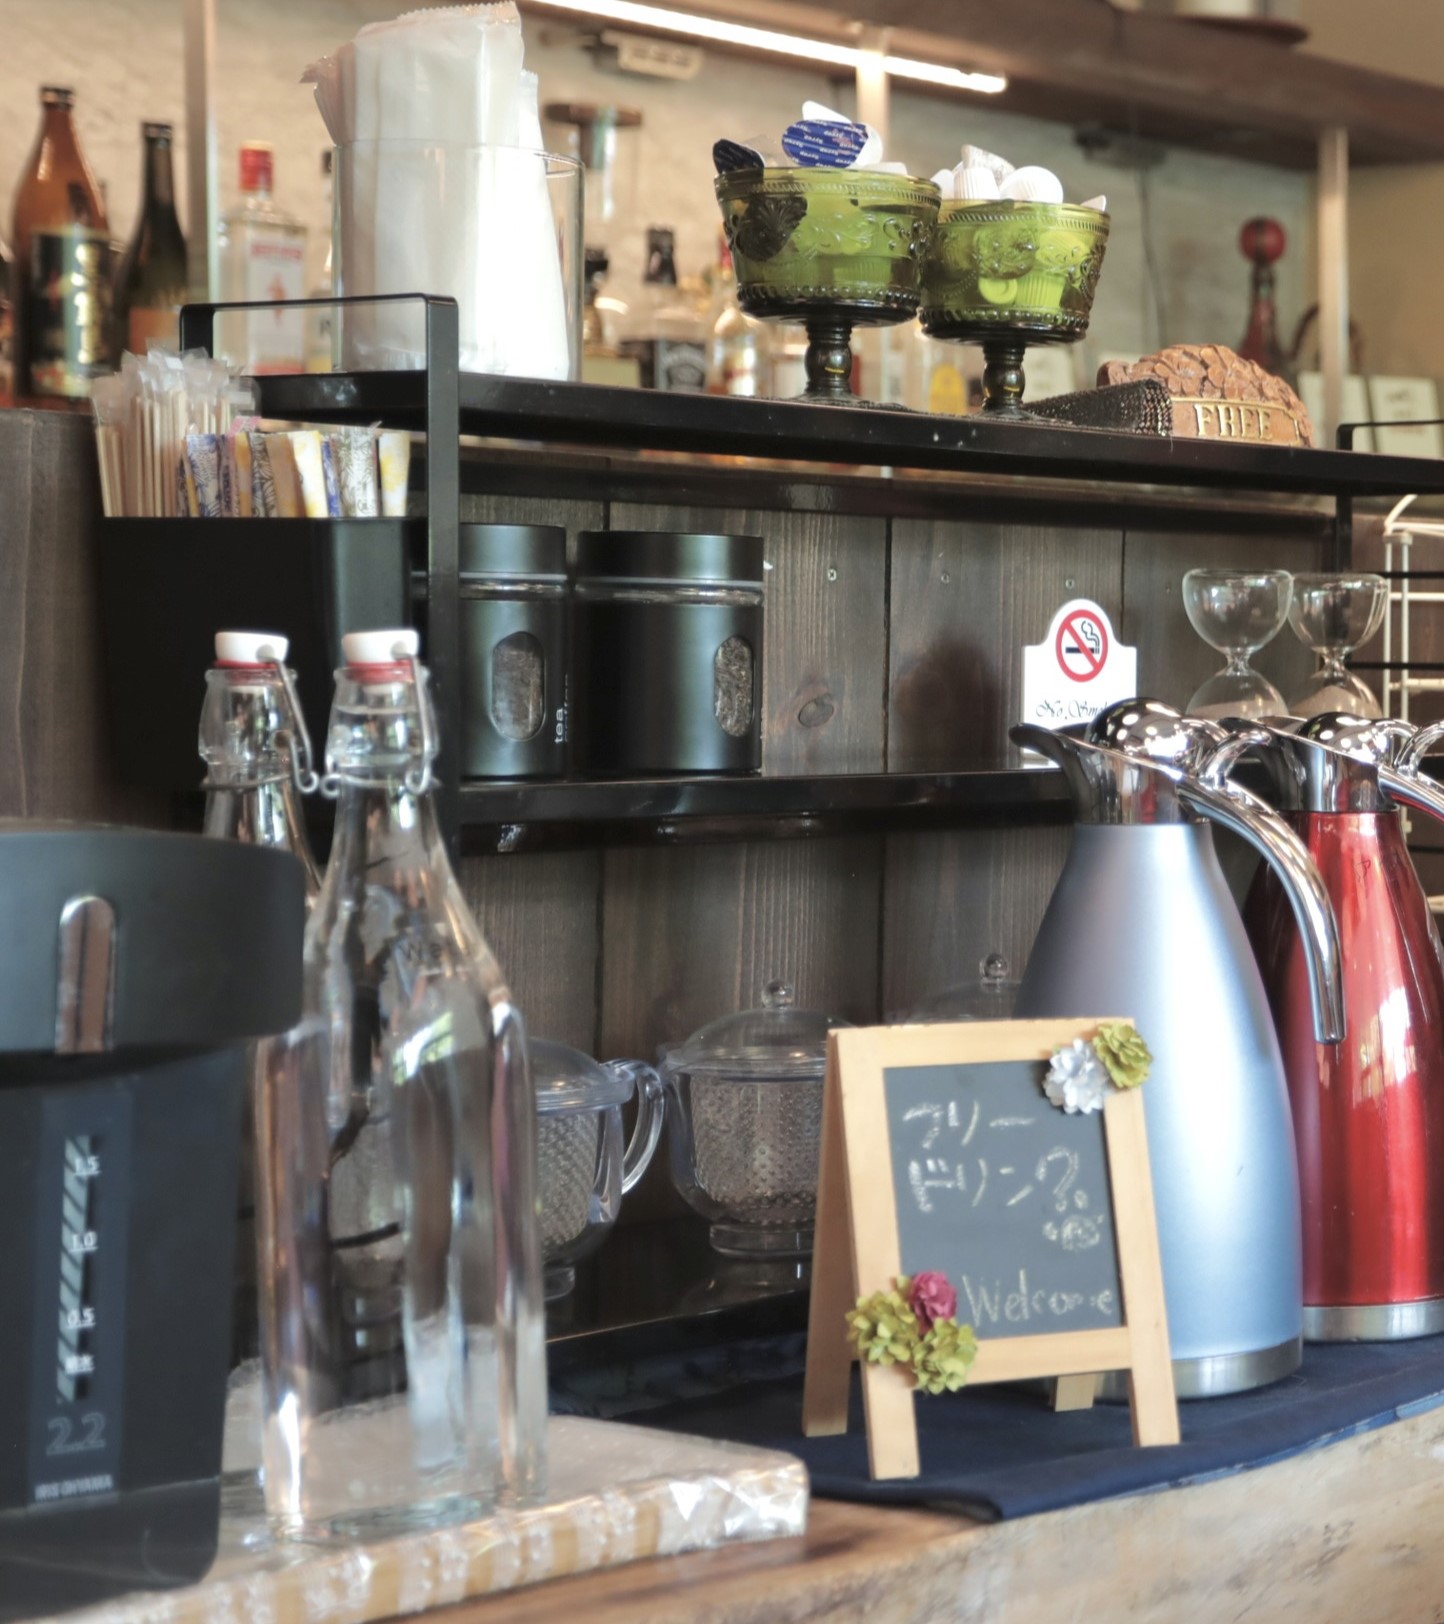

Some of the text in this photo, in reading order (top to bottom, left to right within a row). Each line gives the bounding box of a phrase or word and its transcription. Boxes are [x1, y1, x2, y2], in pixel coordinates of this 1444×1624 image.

[1193, 403, 1273, 440] FREE
[554, 708, 564, 744] tea
[902, 1099, 1037, 1150] フリー
[74, 1156, 100, 1174] 1.5
[71, 1231, 98, 1249] 1.0
[961, 1268, 1113, 1328] Welcome
